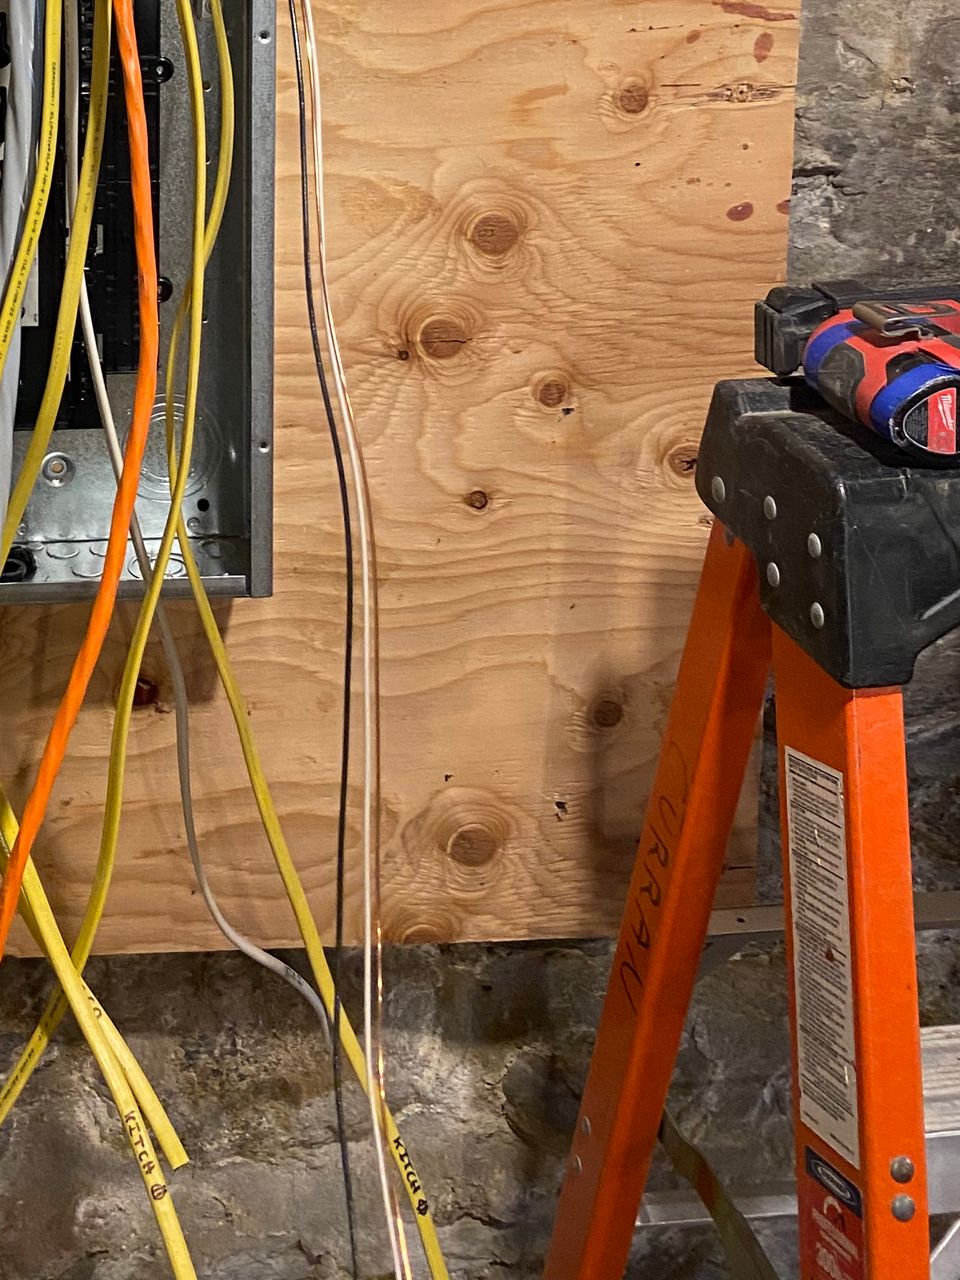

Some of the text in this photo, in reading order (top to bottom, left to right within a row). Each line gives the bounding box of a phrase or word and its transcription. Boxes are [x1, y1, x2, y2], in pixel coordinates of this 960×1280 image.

[619, 741, 688, 1015] CURRAN
[124, 1110, 156, 1175] KITCH
[394, 1136, 420, 1194] KITCH
